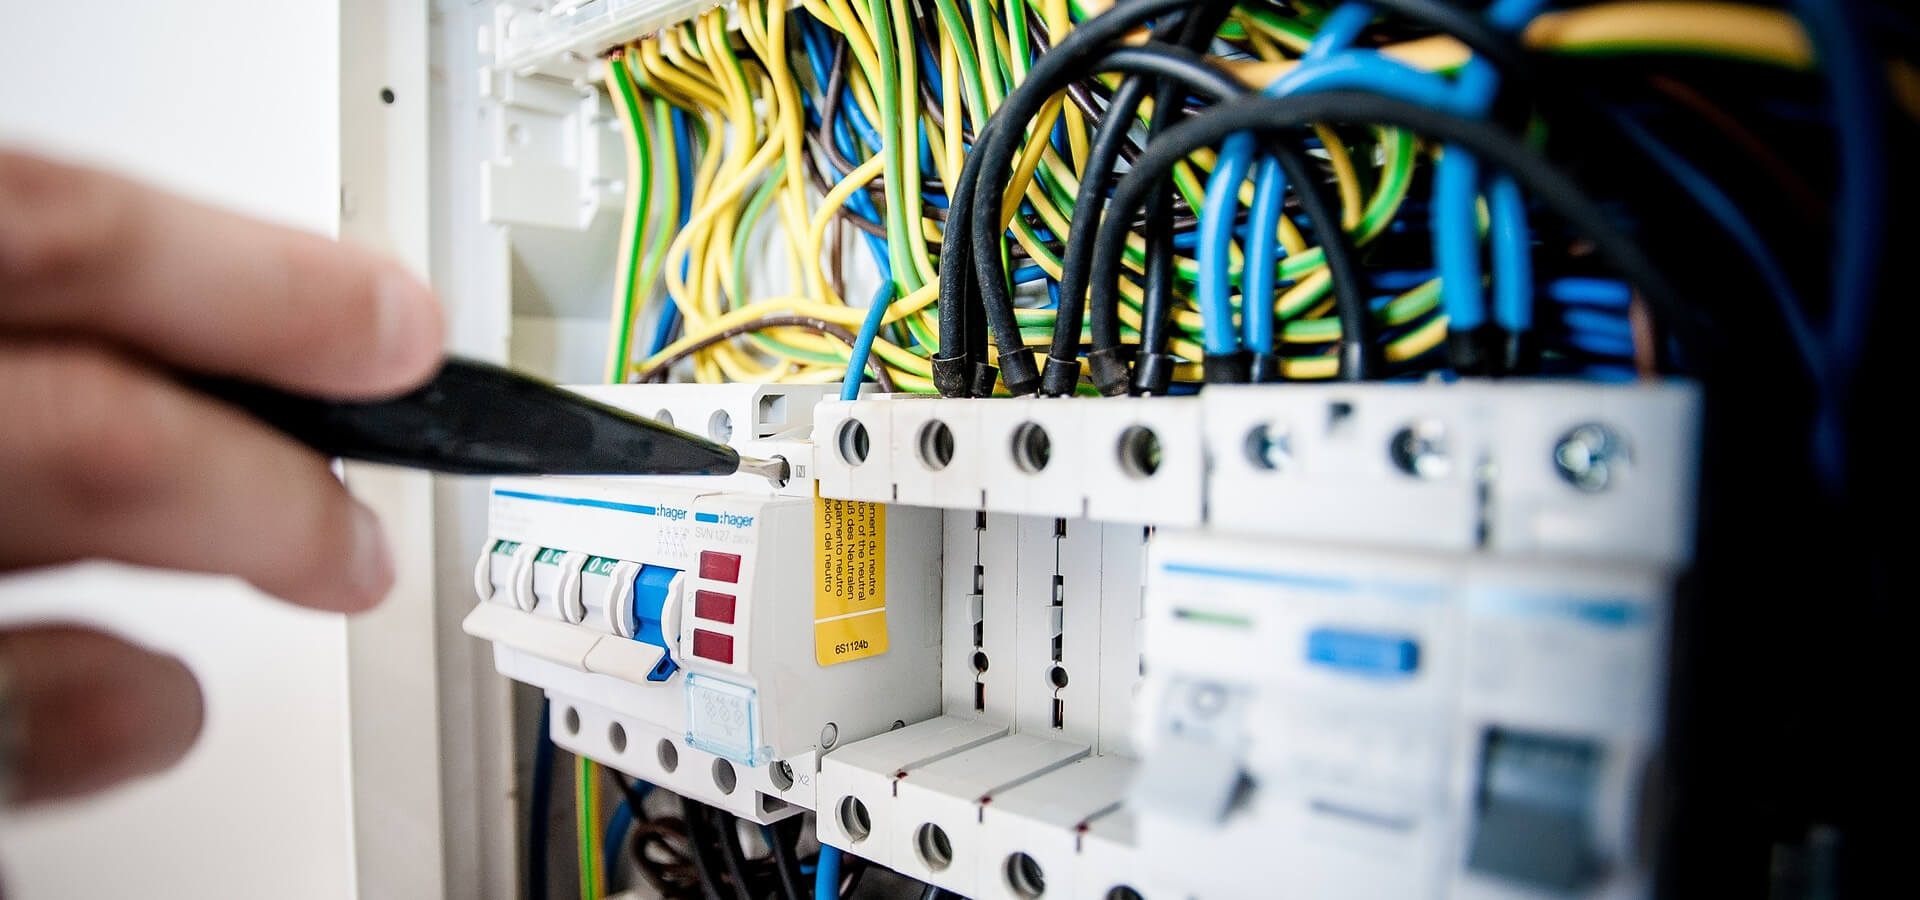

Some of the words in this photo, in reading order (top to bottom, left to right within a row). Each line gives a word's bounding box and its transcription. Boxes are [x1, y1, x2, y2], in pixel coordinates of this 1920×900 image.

[847, 519, 855, 540] des
[858, 525, 866, 536] of
[824, 533, 832, 550] del
[858, 540, 866, 558] the
[868, 541, 876, 556] du
[824, 554, 832, 592] neutro
[847, 544, 855, 600] Neutralen
[858, 562, 866, 601] neutral
[868, 559, 876, 595] neutre
[835, 640, 869, 655] 6S1124b
